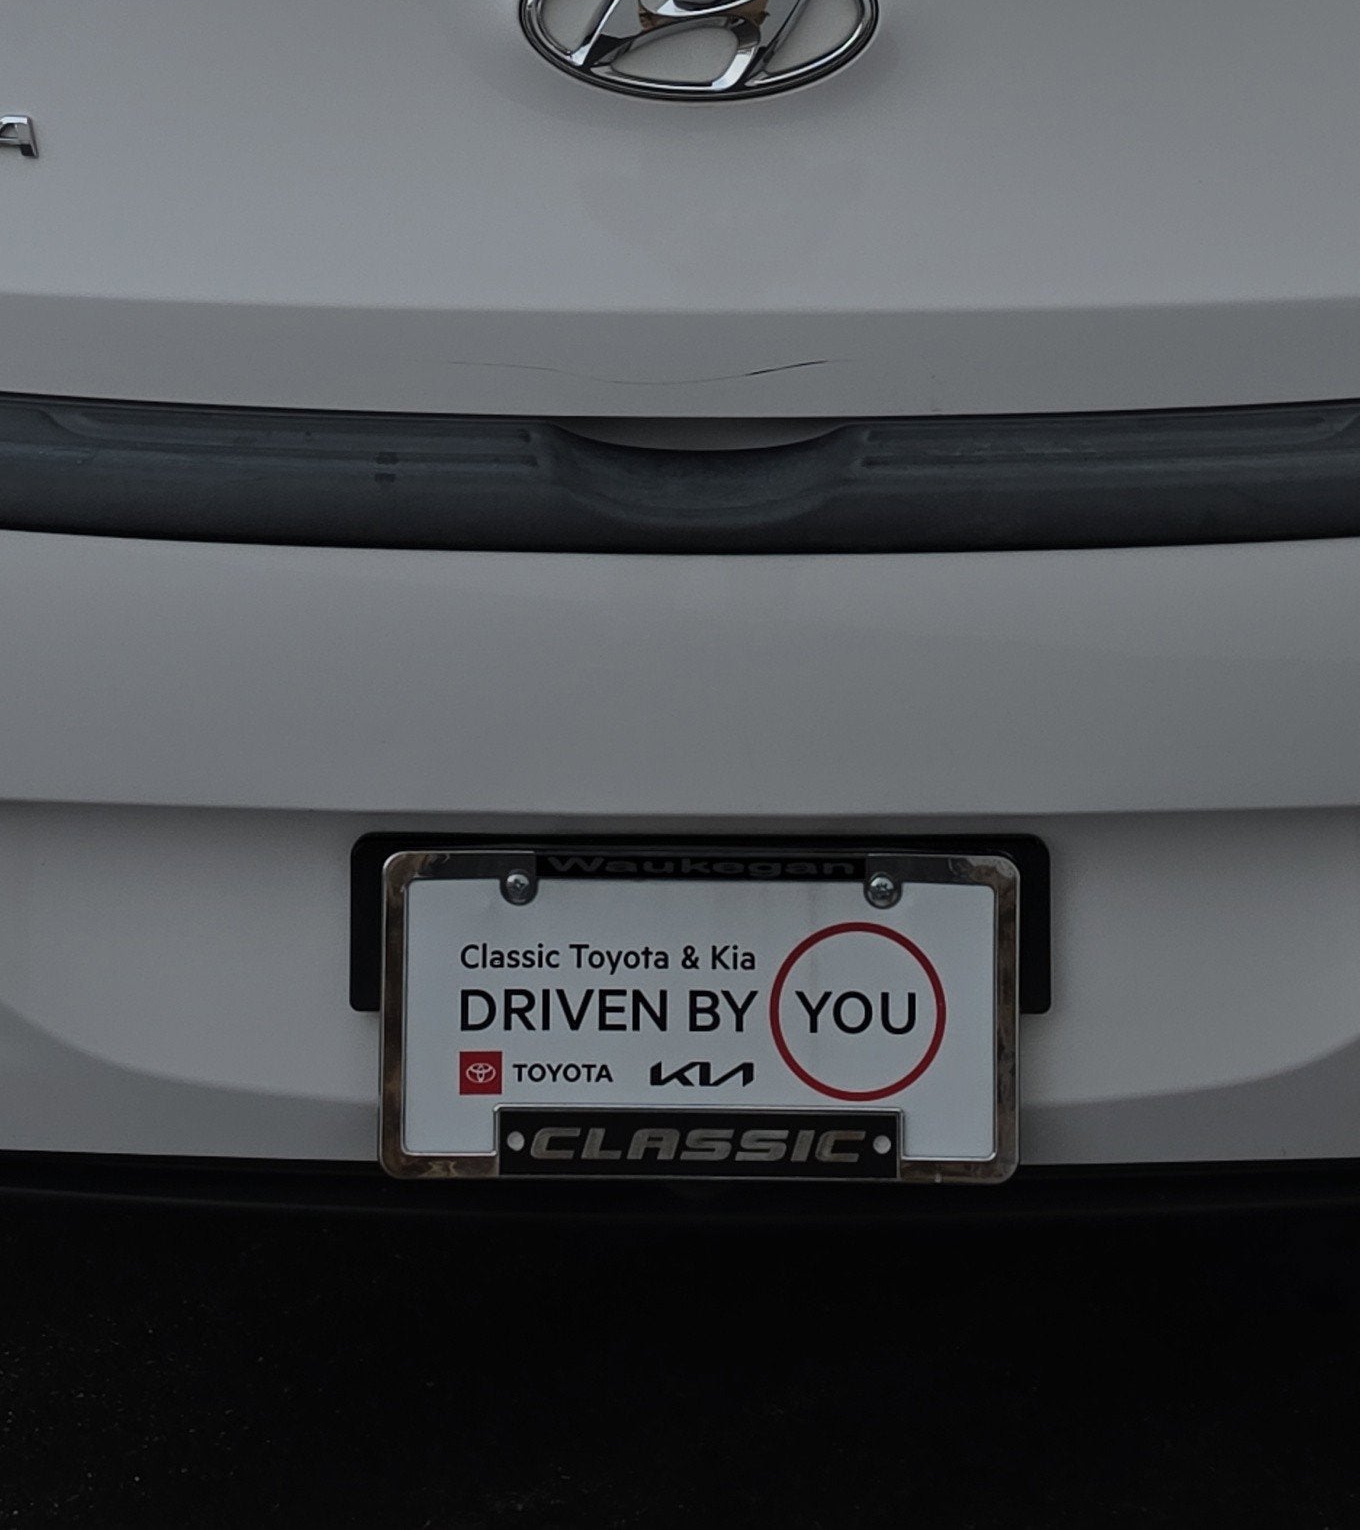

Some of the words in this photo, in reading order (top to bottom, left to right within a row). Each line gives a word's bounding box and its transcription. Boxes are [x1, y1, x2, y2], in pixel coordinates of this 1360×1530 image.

[460, 943, 560, 970] Classic
[569, 943, 669, 975] Toyota
[681, 945, 700, 970] &
[711, 945, 756, 970] Kia
[460, 988, 668, 1032] DRIVEN
[688, 989, 758, 1032] BY
[795, 990, 917, 1035] YOU
[512, 1063, 614, 1083] TOYOTA
[530, 1127, 866, 1162] CLASSIC
